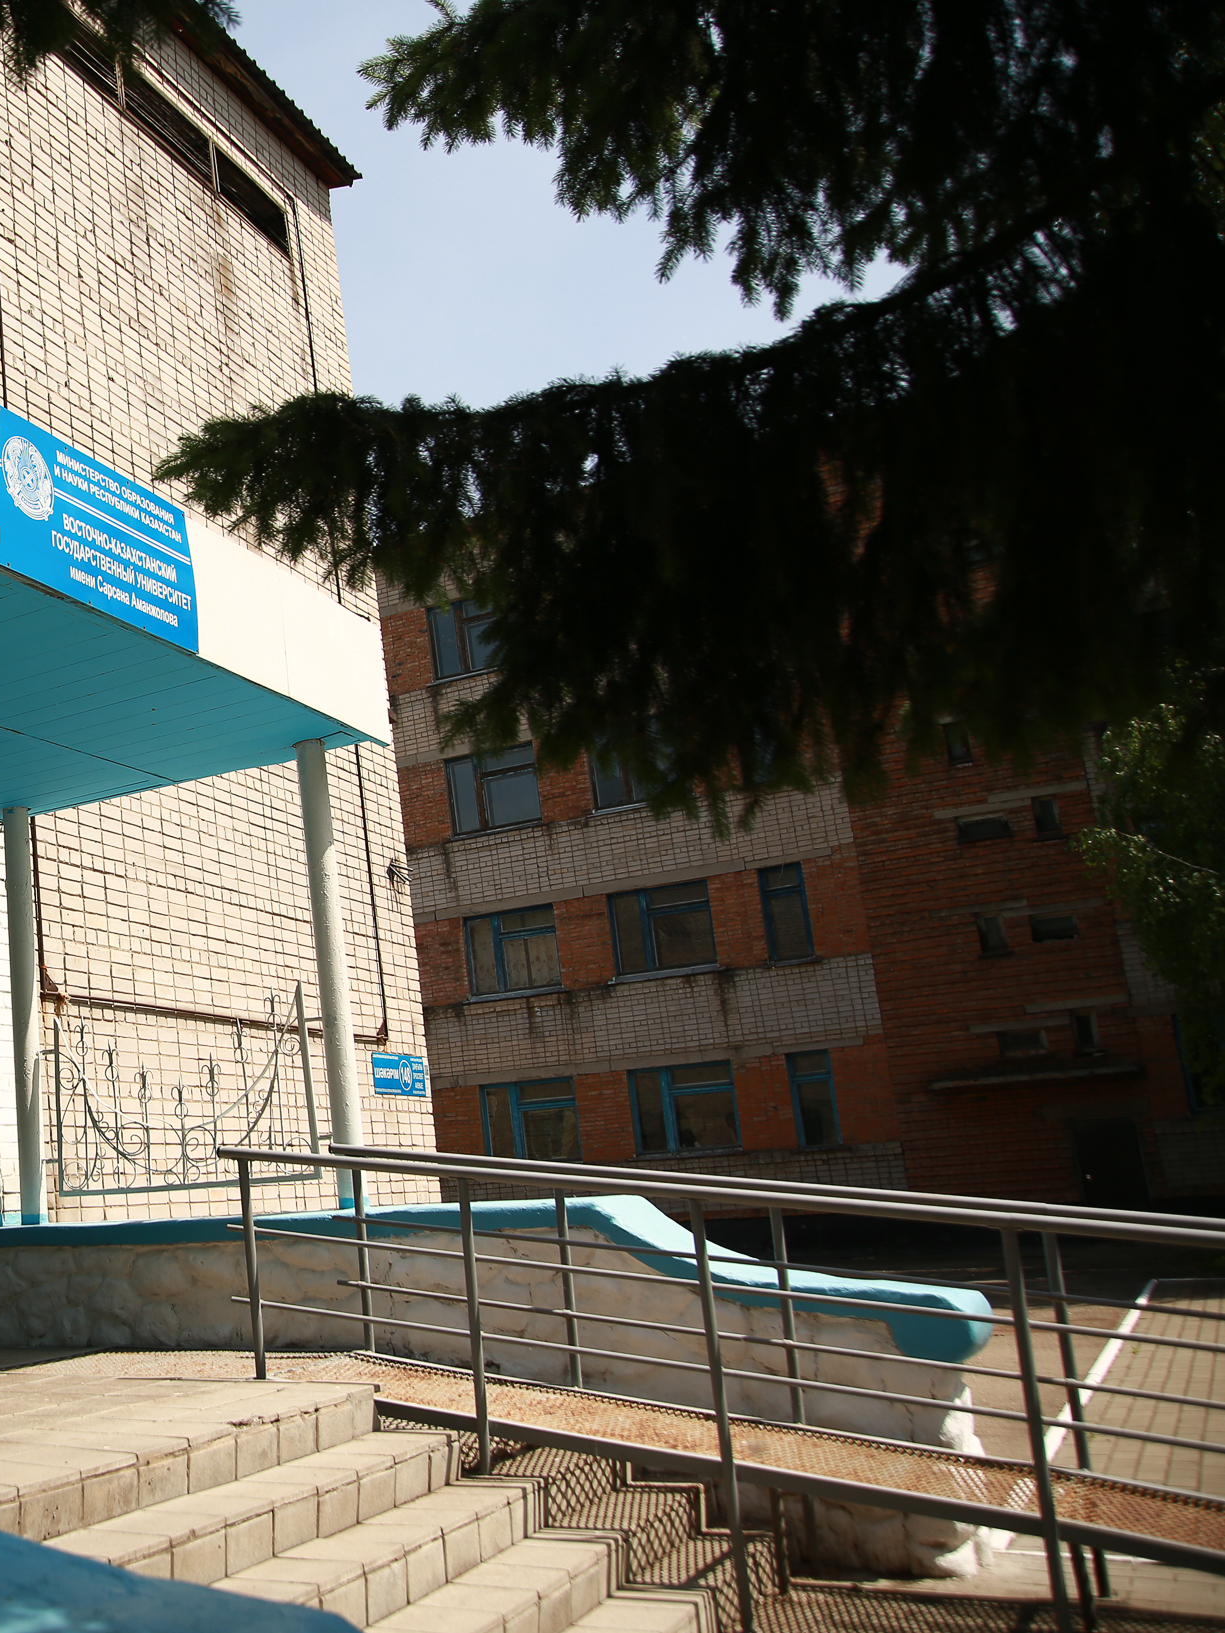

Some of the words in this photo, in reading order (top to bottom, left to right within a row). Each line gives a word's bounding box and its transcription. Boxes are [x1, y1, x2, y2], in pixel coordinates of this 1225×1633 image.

[53, 463, 61, 478] И
[62, 468, 89, 493] НАУКИ
[89, 483, 141, 521] РЕСПУБЛИКИ
[141, 511, 183, 544] КАЗАХСТАН
[56, 450, 121, 495] МИНИСТЕРСТВО
[121, 486, 175, 525] ОБРАЗОВАНИЯ
[51, 529, 136, 586] ГОСУДАРСТВЕННЫЙ
[136, 571, 192, 612] УНИВЕРСИТЕТ
[62, 512, 177, 584] ВОСТОЧНО-КАЗАХСТАНСКИЙ
[69, 565, 96, 589] имени
[97, 575, 130, 605] Сарсена
[131, 592, 179, 628] Аманжолова
